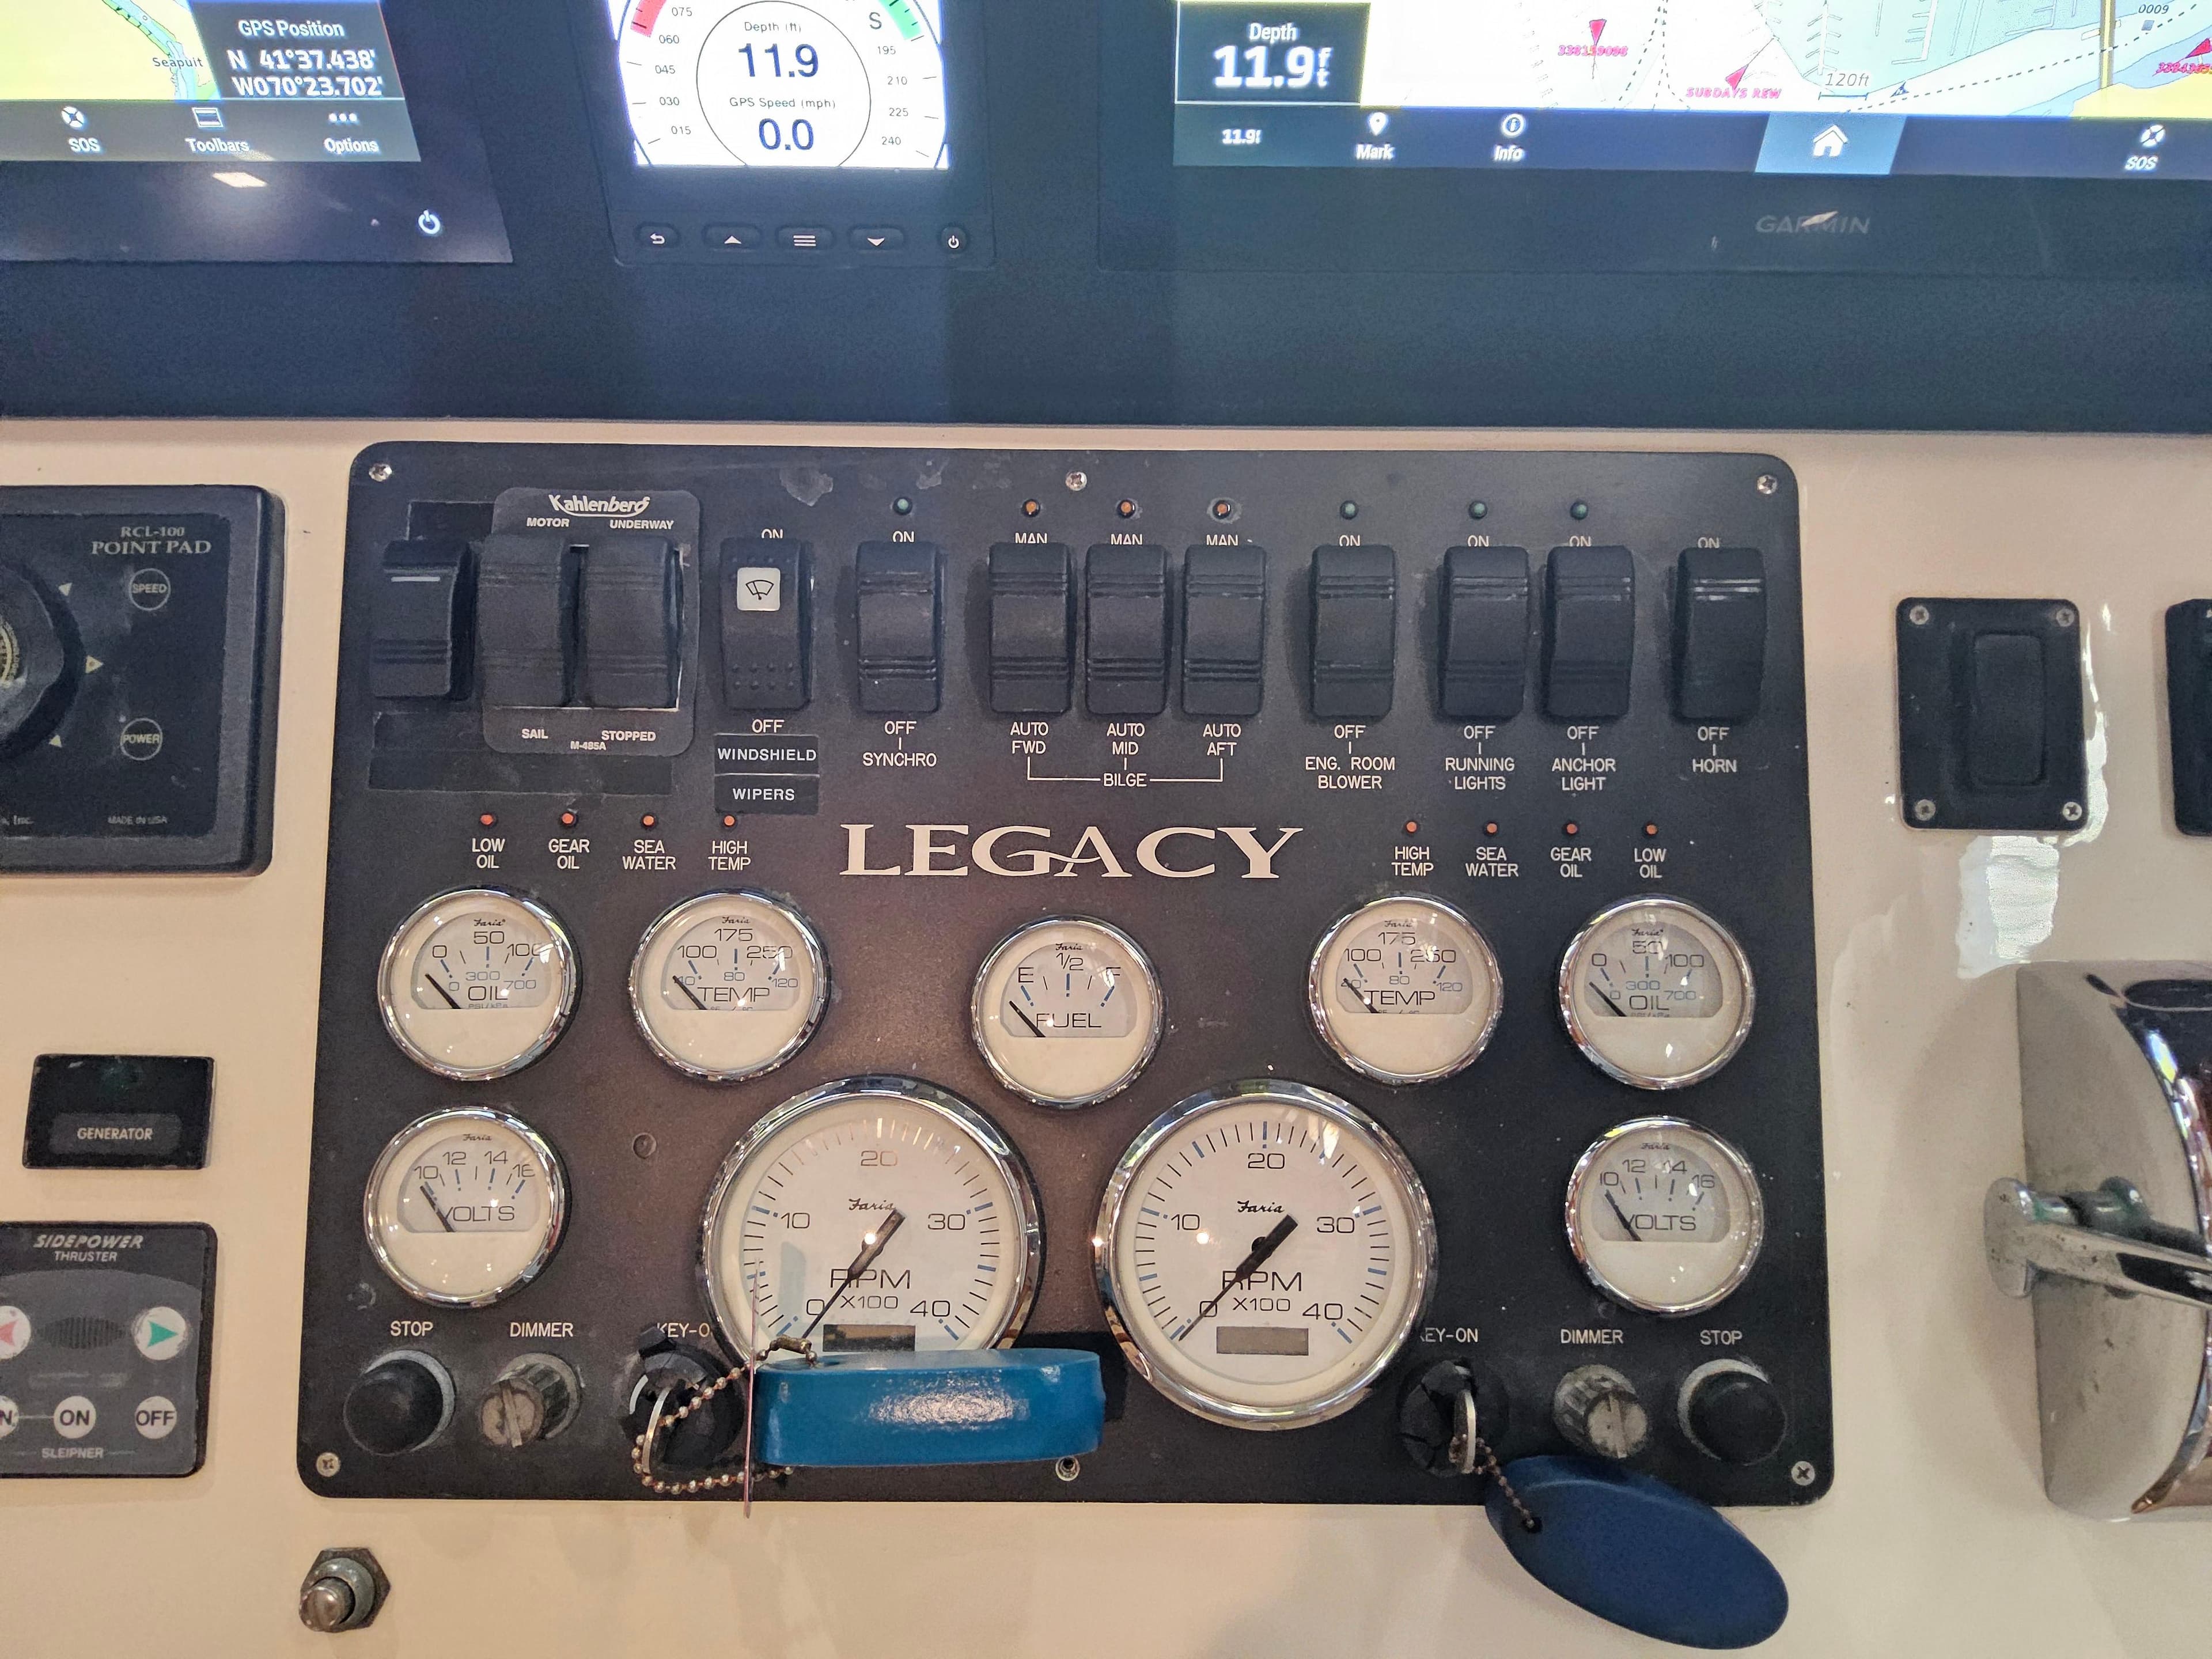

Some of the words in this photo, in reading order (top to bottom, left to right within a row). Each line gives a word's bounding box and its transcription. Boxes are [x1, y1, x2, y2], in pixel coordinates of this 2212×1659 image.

[672, 7, 692, 17] 075
[2138, 5, 2169, 14] 0009
[744, 21, 779, 33] Depth
[869, 12, 882, 30] S
[238, 20, 275, 37] GPS
[278, 20, 344, 37] Position
[1249, 22, 1297, 44] Depth
[658, 35, 679, 44] 060
[877, 46, 896, 55] 195
[152, 56, 203, 70] Seapuit
[738, 43, 819, 78] 11.9
[655, 65, 676, 75] 045
[887, 75, 907, 85] 210
[659, 96, 680, 106] 030
[729, 98, 755, 108] GPS
[759, 98, 795, 109] Speed
[801, 98, 836, 109] (mph)
[889, 107, 908, 117] 225
[671, 126, 691, 135] 015
[759, 118, 814, 150] 0.0
[69, 138, 100, 152] SOS
[185, 138, 249, 153] Toolbars
[324, 139, 378, 154] Options
[881, 136, 901, 146] 240
[1356, 144, 1393, 160] Mark
[1494, 145, 1522, 161] Info
[2124, 155, 2159, 171] SOS
[548, 495, 650, 517] Kahlenberg
[527, 517, 569, 528] MOTOR
[609, 520, 674, 529] UNDERWAY
[121, 526, 184, 537] RCL-100
[892, 531, 915, 541] ON
[1015, 533, 1047, 544] MAN
[1111, 534, 1143, 545] MAN
[1206, 535, 1238, 546] MAN
[1339, 535, 1361, 547] ON
[1468, 536, 1489, 547] ON
[1569, 536, 1591, 547] ON
[1698, 537, 1719, 548] ON
[91, 541, 161, 554] POINT
[166, 540, 211, 554] PAD
[132, 584, 166, 593] SPEED
[752, 719, 785, 733] OFF
[884, 721, 916, 734] OFF
[1010, 722, 1048, 736] AUTO
[1107, 723, 1145, 737] AUTO
[1203, 724, 1241, 737] AUTO
[1334, 725, 1366, 738] OFF
[1464, 726, 1496, 739] OFF
[123, 734, 160, 744] POWER
[522, 729, 548, 738] SAIL
[601, 730, 656, 741] STOPPED
[1567, 726, 1599, 740] OFF
[1697, 727, 1729, 740] OFF
[570, 741, 606, 751] M-485A
[1012, 741, 1046, 754] FWD
[1112, 742, 1138, 755] MID
[1207, 743, 1237, 756] AFT
[718, 749, 817, 762] WINDSHIELD
[863, 752, 937, 767] SYNCHRO
[1305, 756, 1341, 770] ENG.
[1351, 757, 1395, 770] ROOM
[1445, 757, 1514, 771] RUNNING
[1552, 758, 1616, 772] ANCHOR
[1692, 759, 1737, 772] HORN
[1104, 774, 1147, 787] BILGE
[1318, 775, 1382, 789] BLOWER
[1454, 777, 1506, 790] LIGHTS
[1562, 777, 1606, 791] LIGHT
[733, 789, 795, 801] WIPERS
[472, 838, 505, 853] LOW
[548, 839, 590, 853] GEAR
[634, 840, 665, 854] SEA
[712, 840, 747, 854] HIGH
[839, 824, 1304, 879] LEGACY
[1395, 846, 1430, 860] HIGH
[1476, 847, 1506, 861] SEA
[1550, 848, 1592, 862] GEAR
[1634, 848, 1666, 862] LOW
[476, 855, 499, 869] OIL
[557, 855, 579, 869] OIL
[622, 857, 676, 870] WATER
[708, 857, 751, 871] TEMP
[1391, 862, 1434, 876] TEMP
[1465, 863, 1518, 877] WATER
[1560, 864, 1582, 878] OIL
[1639, 865, 1662, 878] OIL
[474, 931, 505, 944] 50
[714, 929, 753, 942] 175
[1378, 932, 1416, 945] 175
[432, 945, 447, 957] 0
[677, 945, 717, 958] 100
[747, 946, 793, 959] 250
[1633, 941, 1662, 954] 50
[1343, 949, 1381, 961] 100
[1592, 953, 1607, 966] 0
[1665, 955, 1704, 967] 100
[465, 971, 500, 981] 300
[724, 972, 745, 981] 80
[1018, 967, 1034, 983] E
[1389, 976, 1410, 984] 80
[449, 982, 459, 991] 0
[503, 980, 536, 990] 700
[772, 978, 798, 987] 120
[1437, 982, 1462, 991] 120
[1626, 980, 1660, 990] 300
[468, 986, 508, 1001] OIL
[697, 987, 770, 1002] TEMP
[1364, 990, 1435, 1005] TEMP
[1664, 991, 1696, 1000] 700
[1629, 995, 1669, 1010] OIL
[1036, 1013, 1101, 1028] FUEL
[77, 1128, 153, 1140] GENERATOR
[442, 1152, 467, 1165] 12
[484, 1150, 508, 1164] 14
[861, 1150, 898, 1166] 20
[1248, 1153, 1285, 1169] 20
[414, 1166, 438, 1179] 10
[1622, 1160, 1646, 1173] 12
[1663, 1160, 1687, 1173] 14
[1692, 1175, 1715, 1188] 16
[849, 1198, 896, 1210] Faria
[1237, 1200, 1285, 1213] Faria
[441, 1206, 515, 1222] VOLTS
[781, 1212, 810, 1229] 10
[927, 1214, 965, 1230] 30
[1171, 1214, 1200, 1230] 10
[1317, 1217, 1355, 1233] 30
[1623, 1214, 1696, 1230] VOLTS
[33, 1235, 144, 1249] SIDEPOWER
[54, 1251, 118, 1262] THRUSTER
[830, 1268, 910, 1289] RPM
[1222, 1270, 1302, 1291] RPM
[806, 1299, 825, 1315] 0
[910, 1300, 950, 1317] 40
[1302, 1304, 1343, 1320] 40
[391, 1321, 433, 1336] STOP
[510, 1323, 574, 1338] DIMMER
[1560, 1329, 1623, 1344] DIMMER
[1699, 1331, 1743, 1345] STOP
[59, 1410, 90, 1425] ON
[135, 1410, 174, 1426] OFF
[41, 1447, 104, 1459] SLEIPNER
